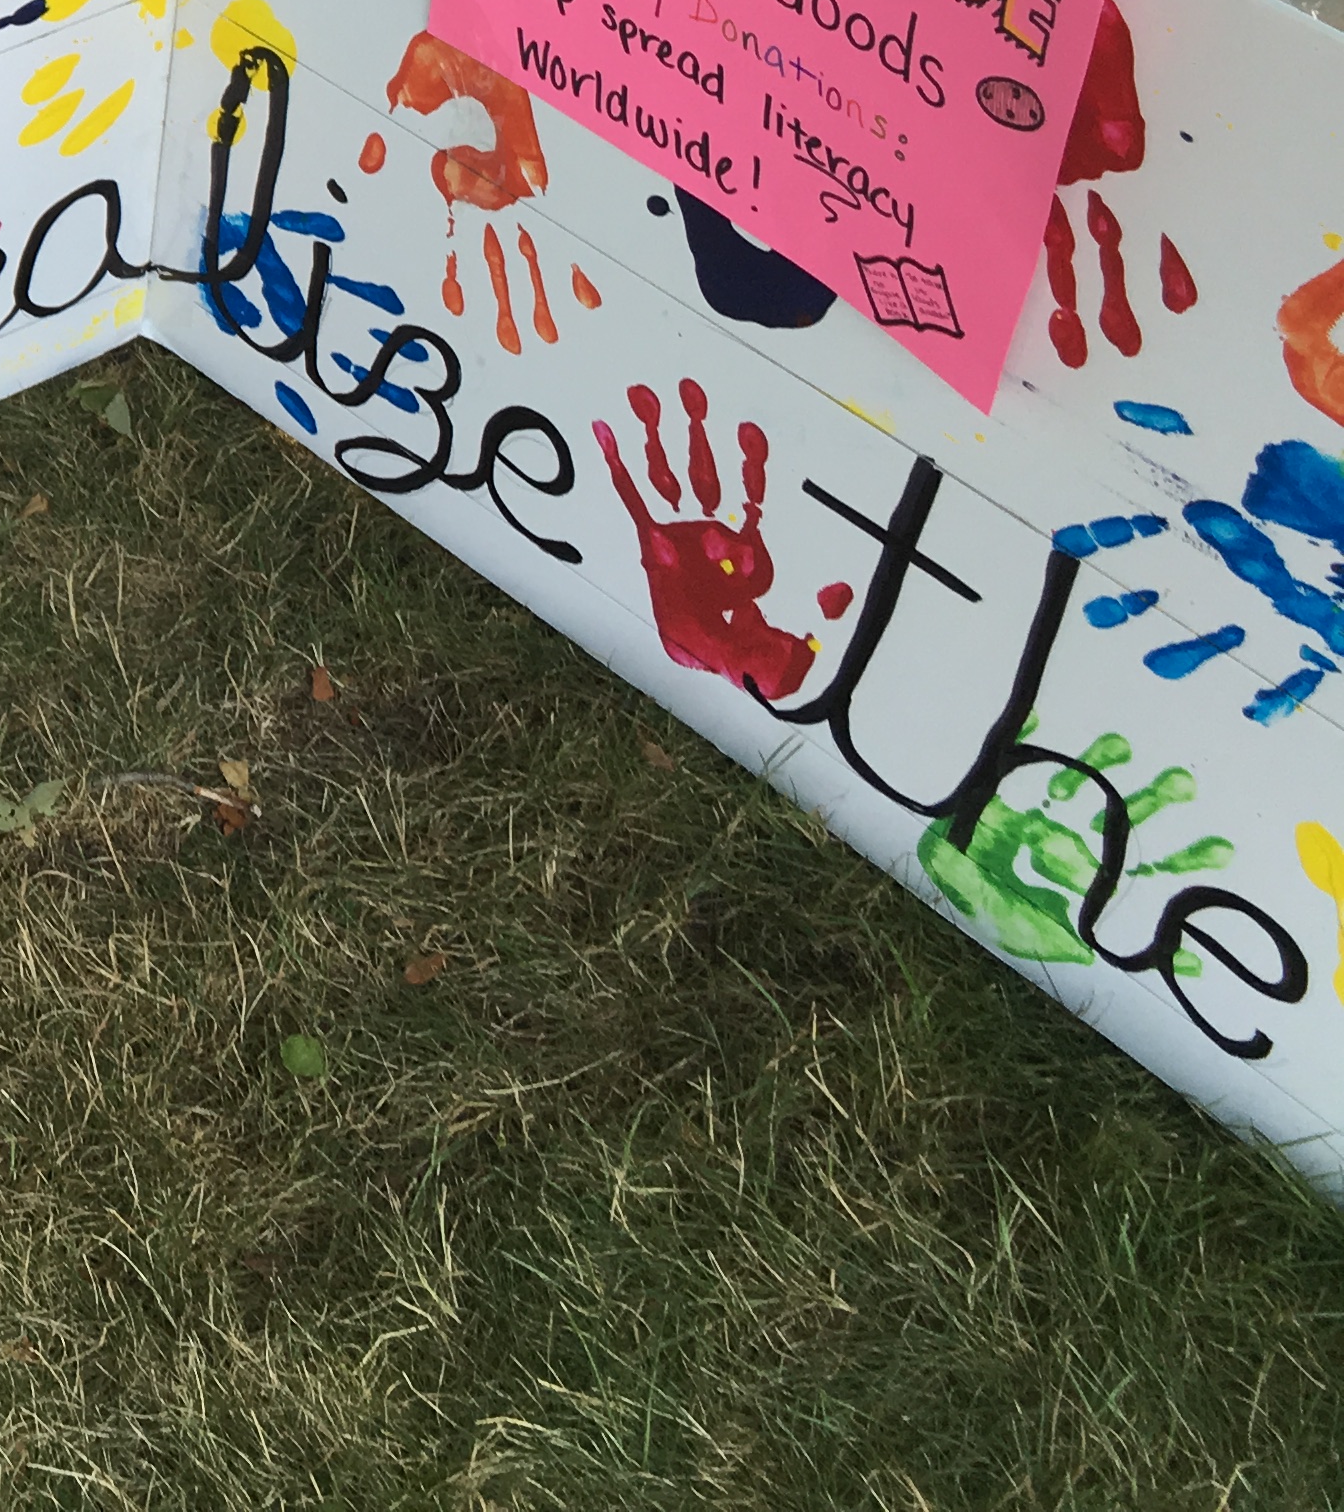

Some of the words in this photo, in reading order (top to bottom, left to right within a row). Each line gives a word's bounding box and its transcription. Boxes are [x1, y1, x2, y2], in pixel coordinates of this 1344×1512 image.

[516, 27, 762, 213] Worldwide!
[601, 1, 725, 103] spread
[762, 92, 915, 247] literacy
[740, 456, 1309, 1060] the
